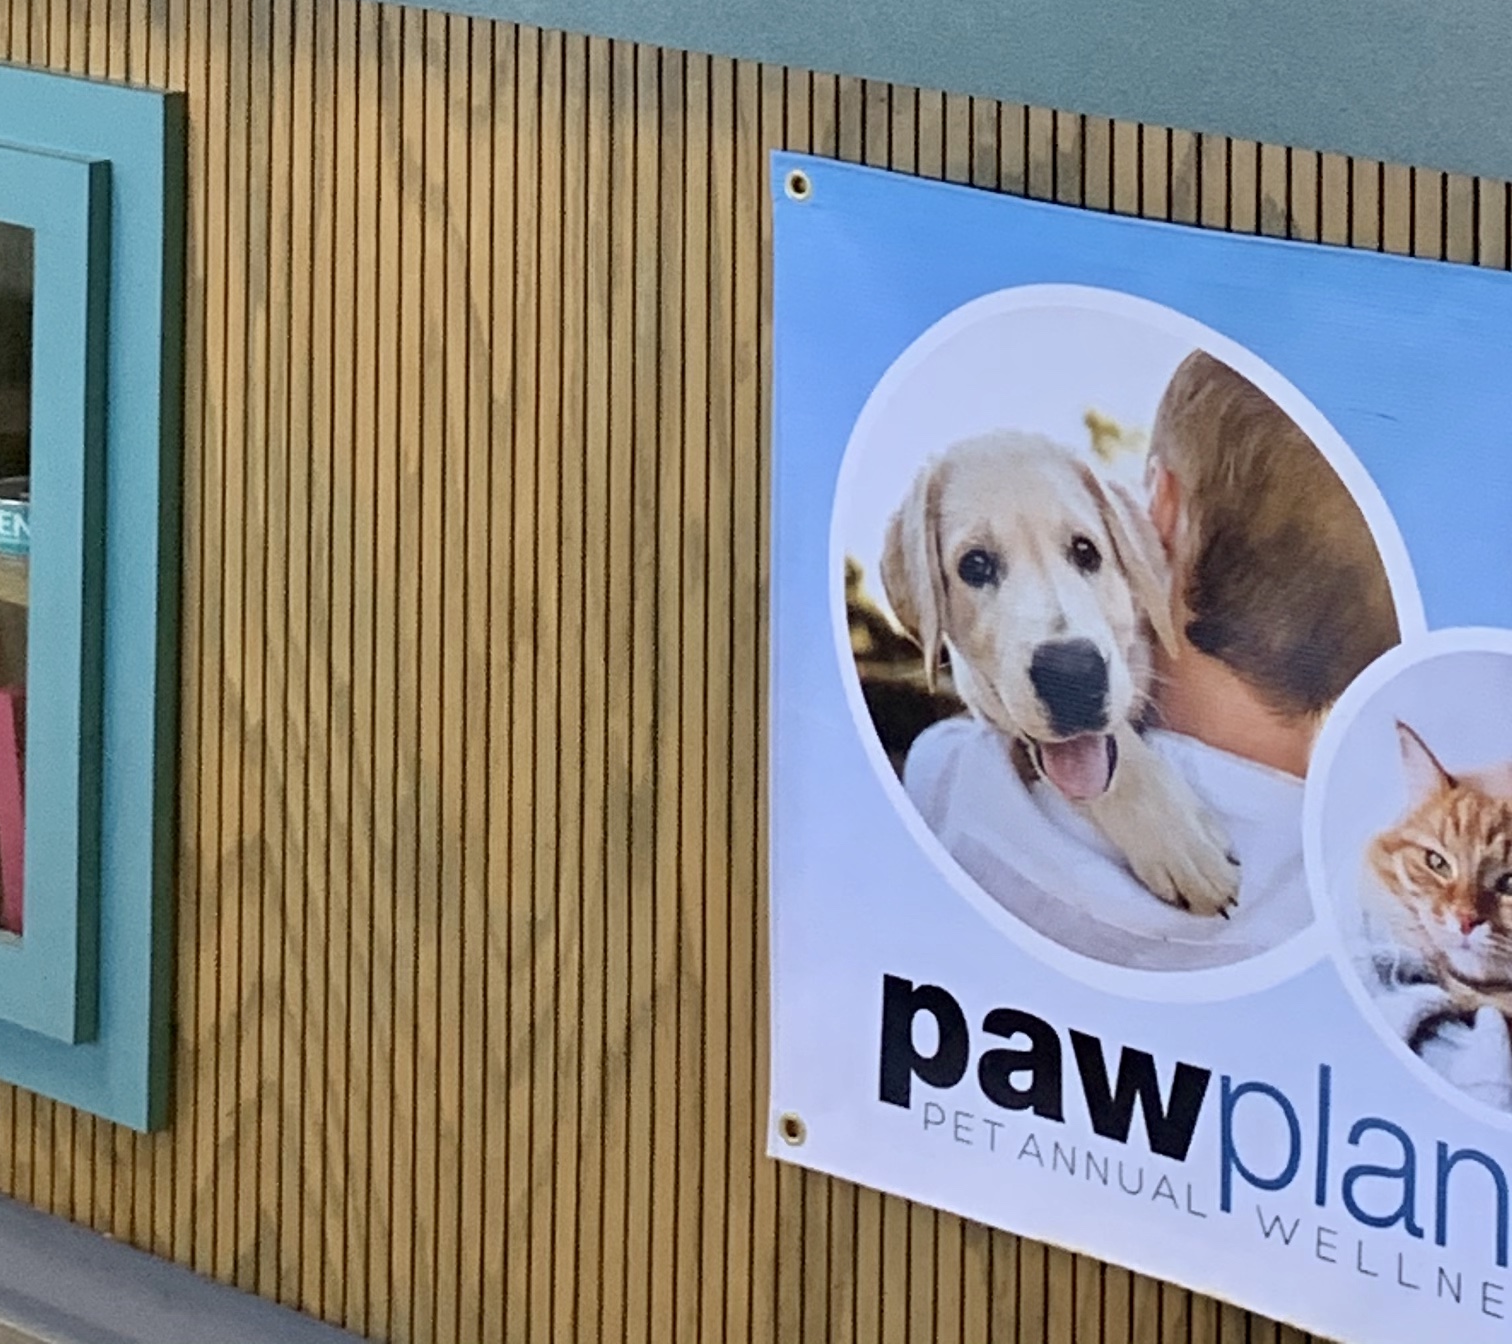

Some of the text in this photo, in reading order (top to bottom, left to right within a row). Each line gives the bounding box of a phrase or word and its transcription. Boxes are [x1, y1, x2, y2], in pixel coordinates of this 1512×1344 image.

[878, 972, 1510, 1269] pawplan
[922, 1100, 1507, 1321] PET ANNUAL WELLNE
